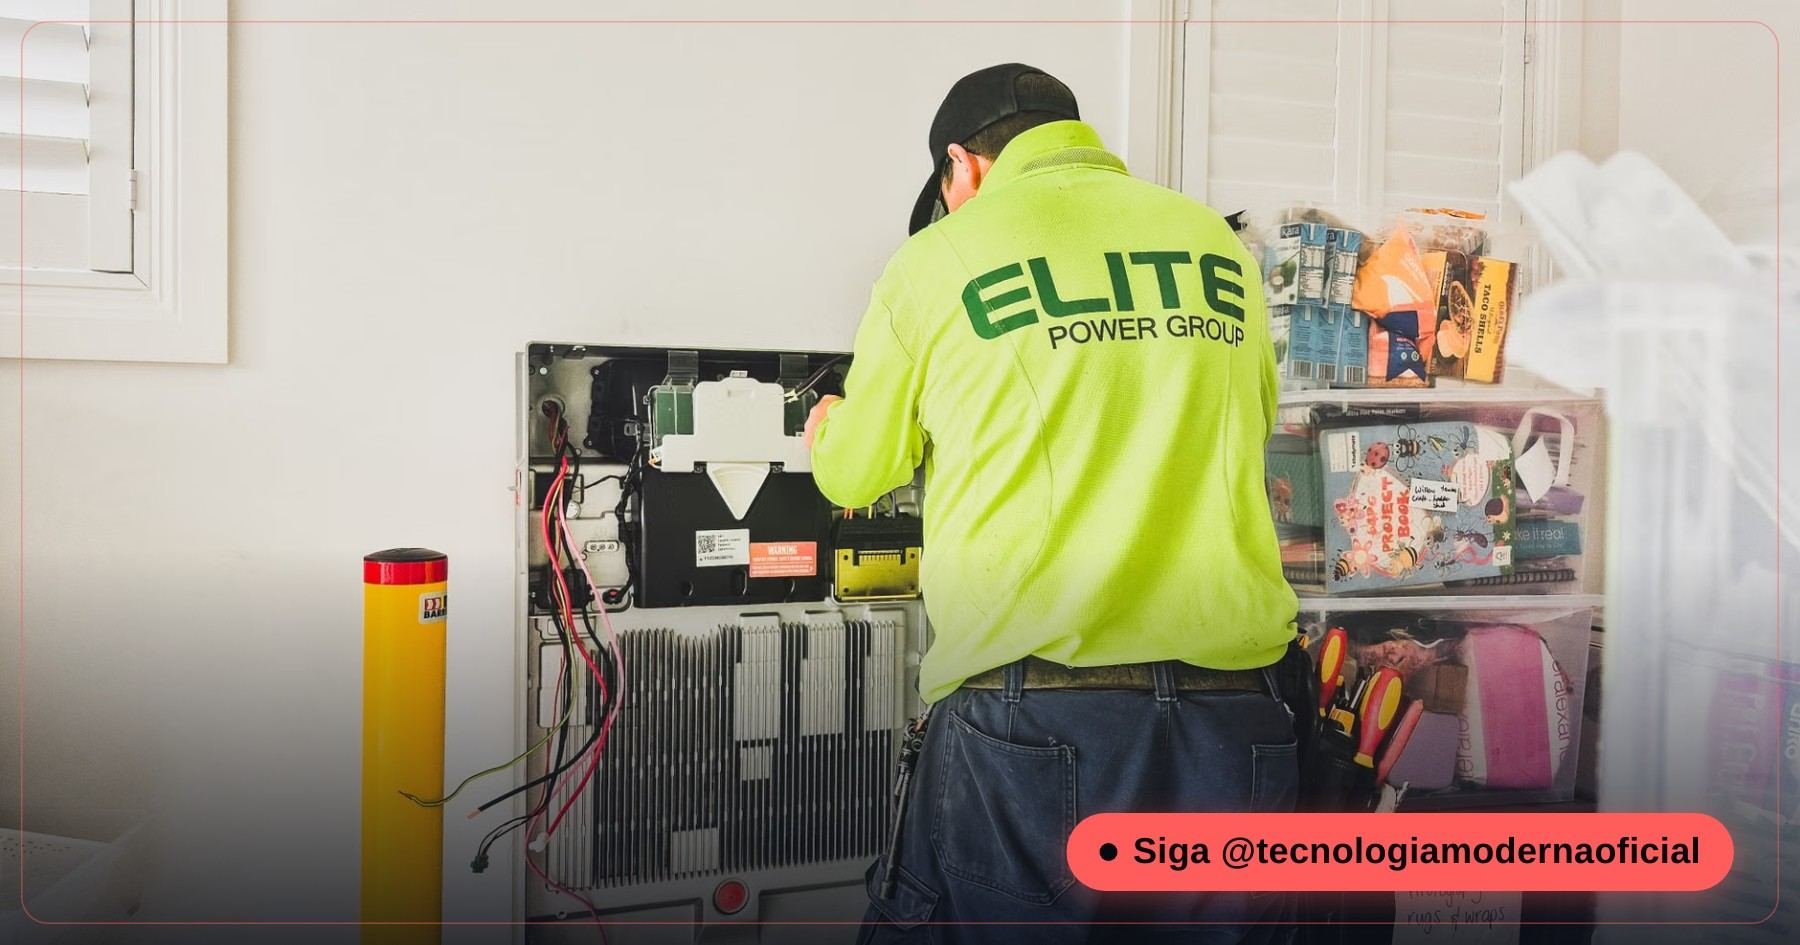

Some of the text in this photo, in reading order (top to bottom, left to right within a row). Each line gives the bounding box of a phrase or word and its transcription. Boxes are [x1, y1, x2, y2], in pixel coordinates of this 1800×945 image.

[961, 251, 1245, 340] ELITE
[1474, 284, 1491, 353] TACO SHELLS
[1049, 315, 1245, 349] POWER GROUP
[1381, 477, 1393, 552] PROJECT
[1397, 489, 1410, 538] BOOK
[1464, 906, 1505, 930] wraps
